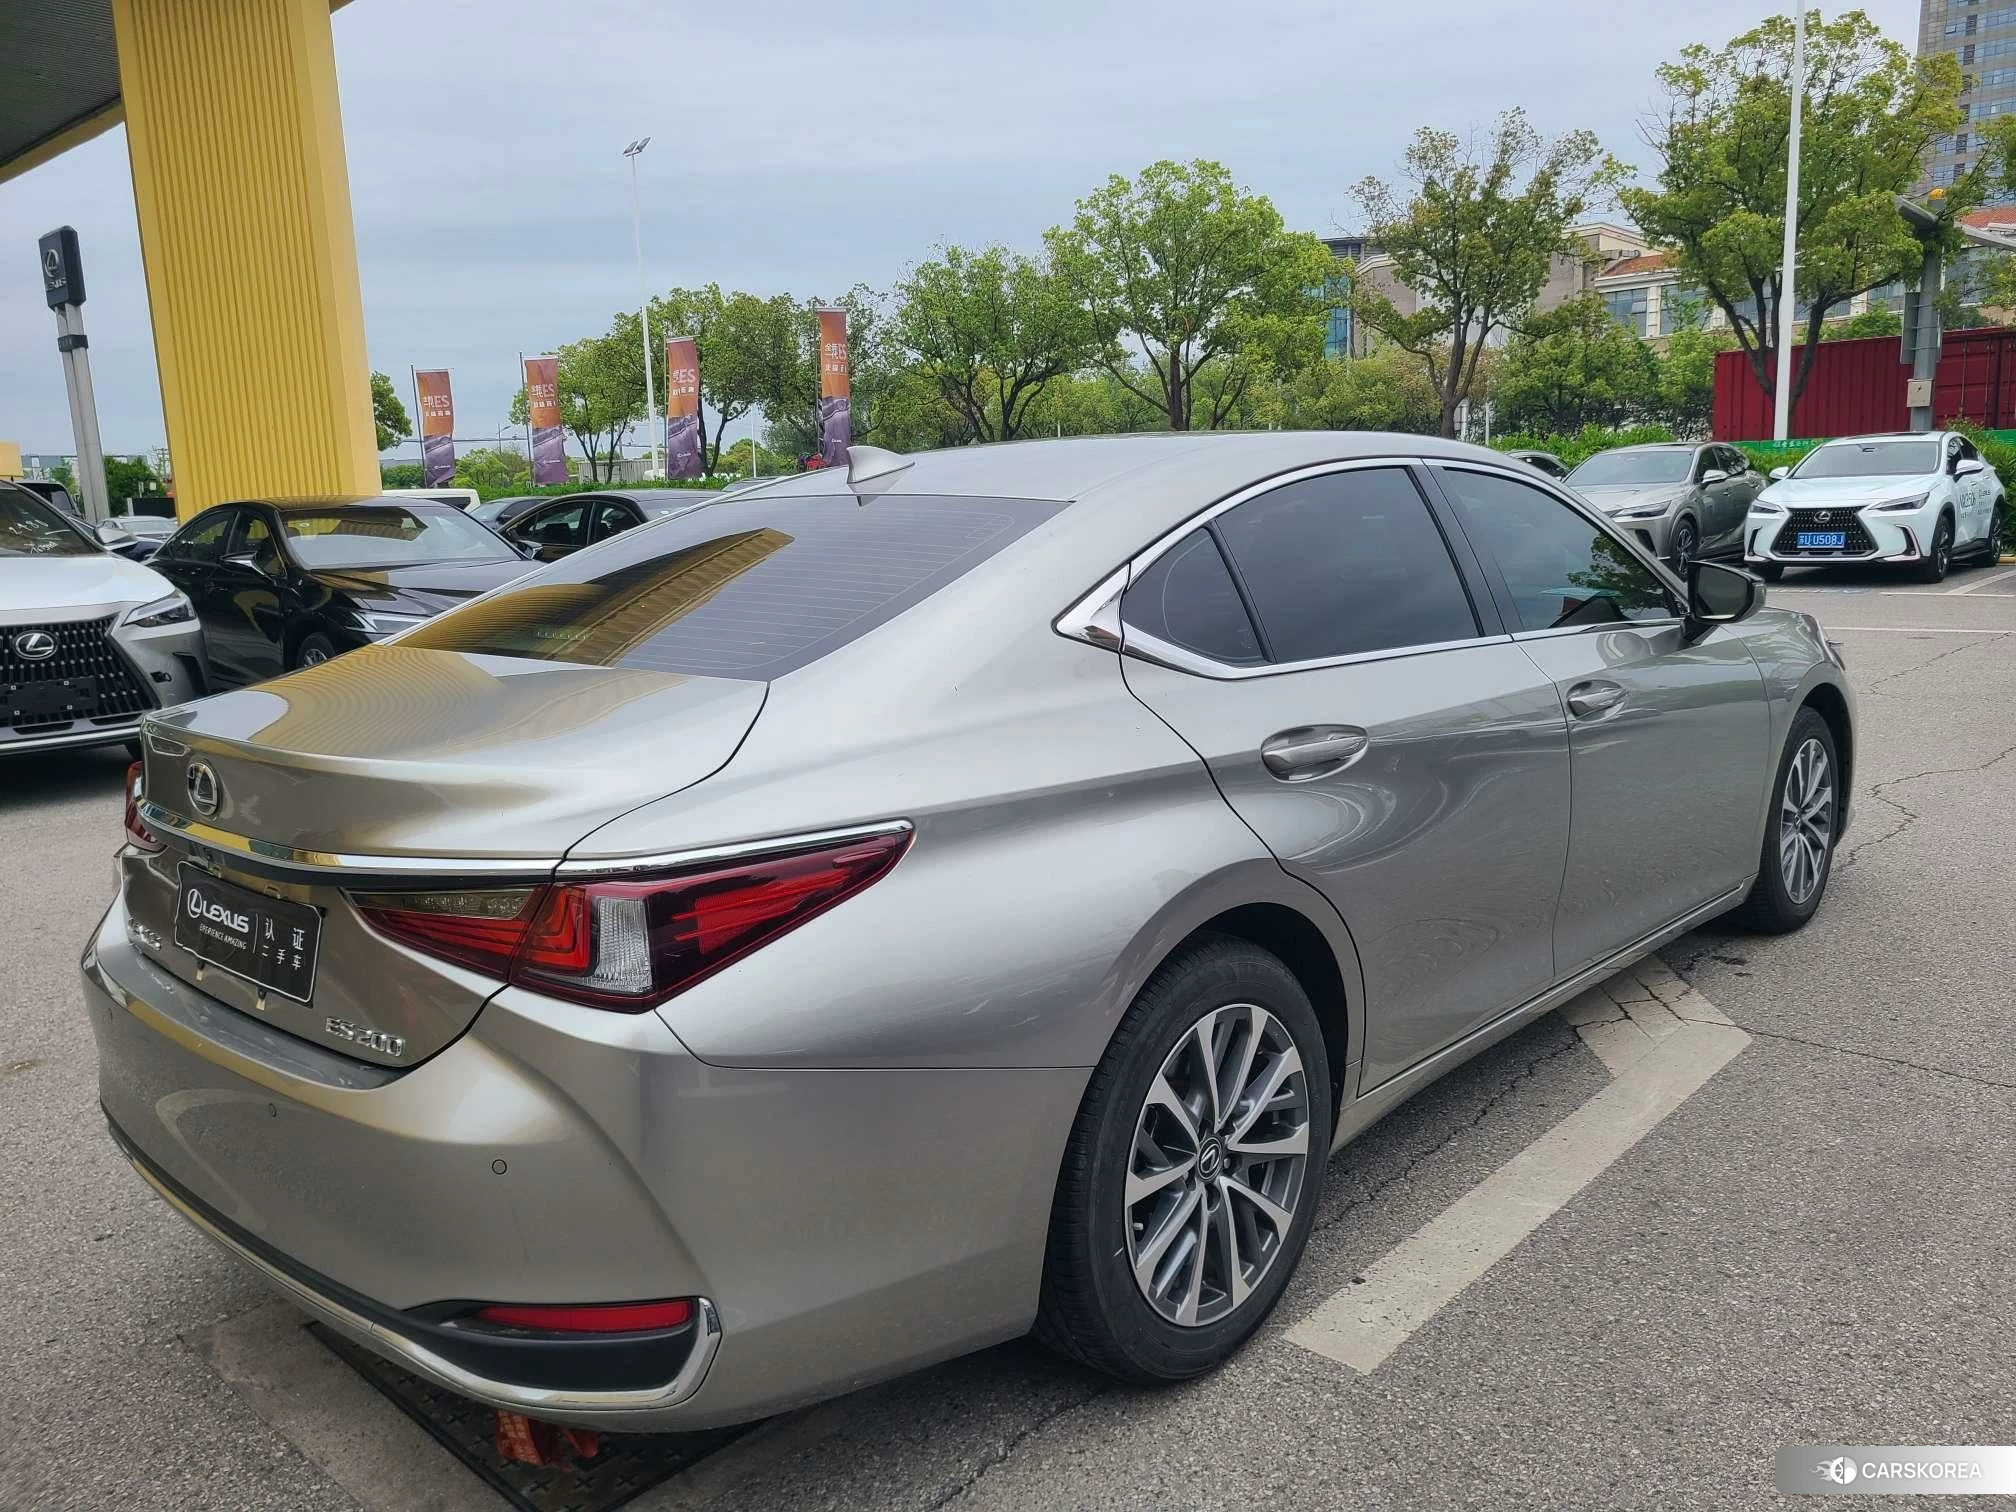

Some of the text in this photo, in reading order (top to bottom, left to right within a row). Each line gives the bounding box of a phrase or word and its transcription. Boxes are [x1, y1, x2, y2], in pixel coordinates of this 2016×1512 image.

[202, 900, 249, 933] LEXUS
[199, 922, 248, 950] EPERIENCE AMAZING
